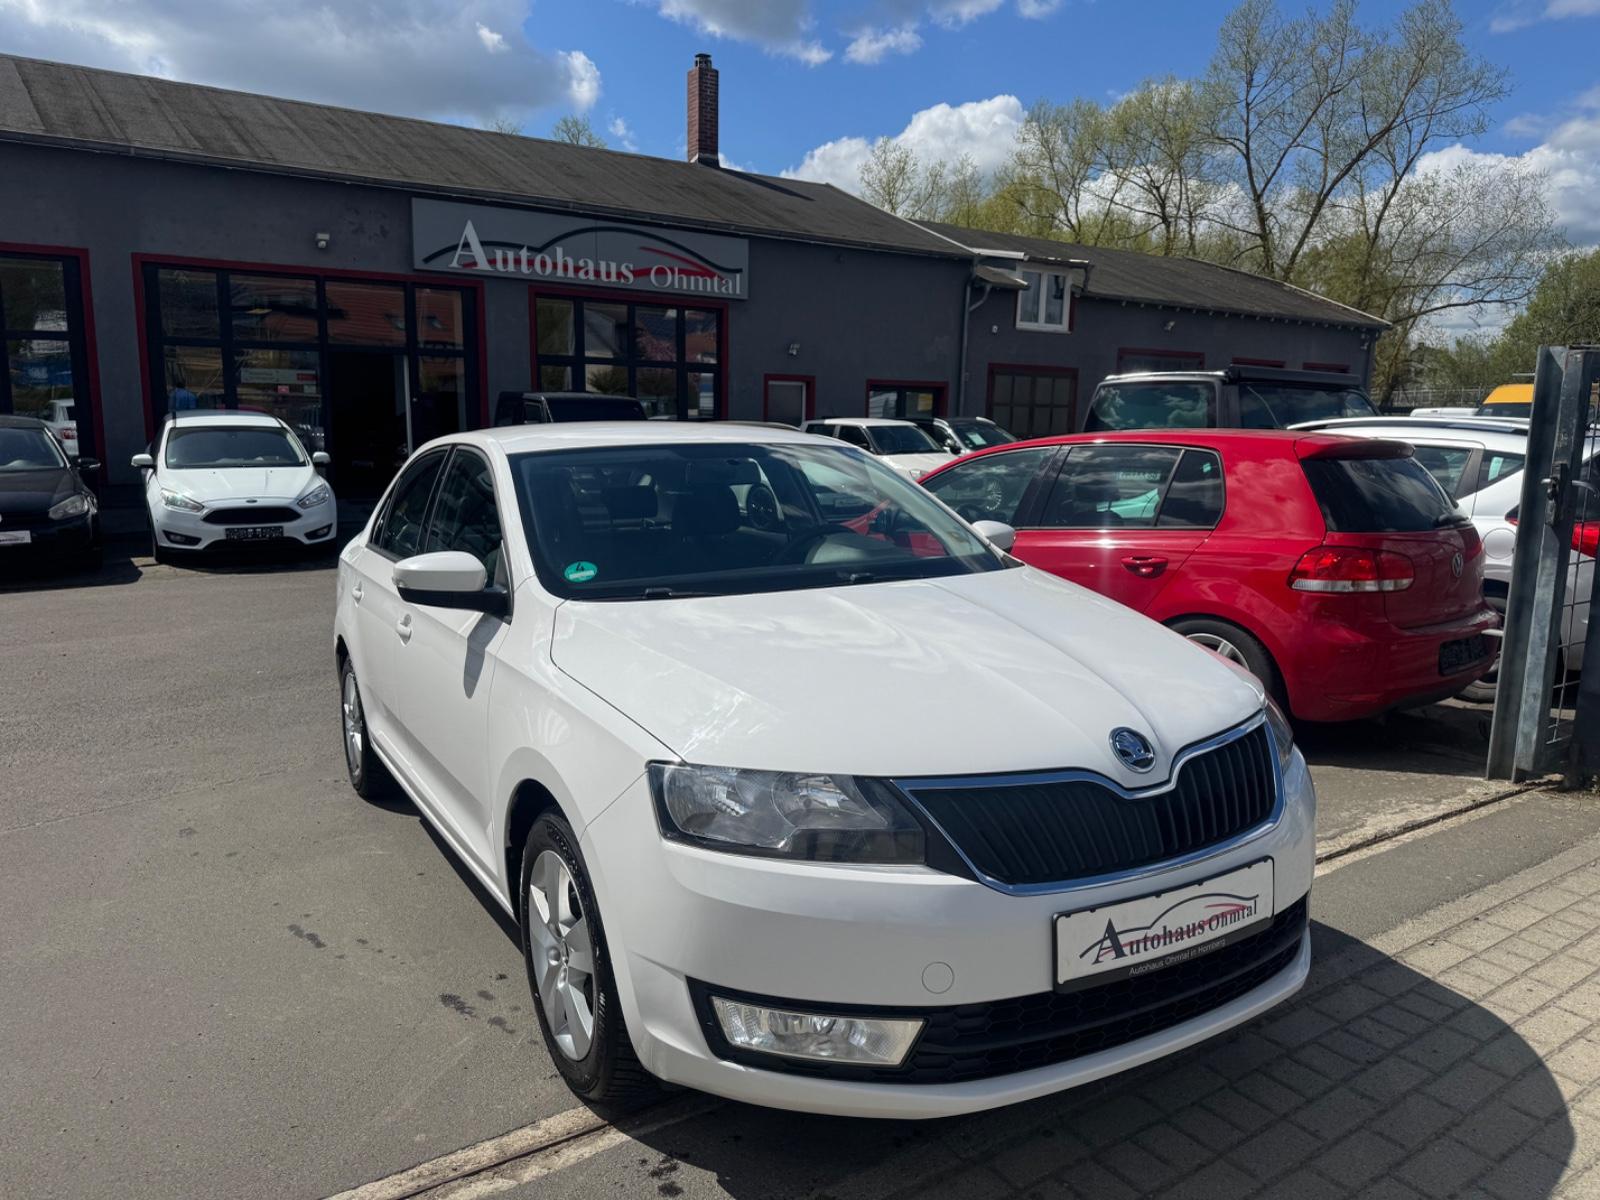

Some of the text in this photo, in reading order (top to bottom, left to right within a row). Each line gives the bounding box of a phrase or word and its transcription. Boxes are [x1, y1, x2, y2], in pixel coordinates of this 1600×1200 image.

[448, 219, 742, 296] Autohaus Ohmtal
[1091, 899, 1257, 965] Autohaus Ohmtal
[1129, 961, 1164, 977] Autohaus
[1165, 950, 1190, 966] Ohmtal
